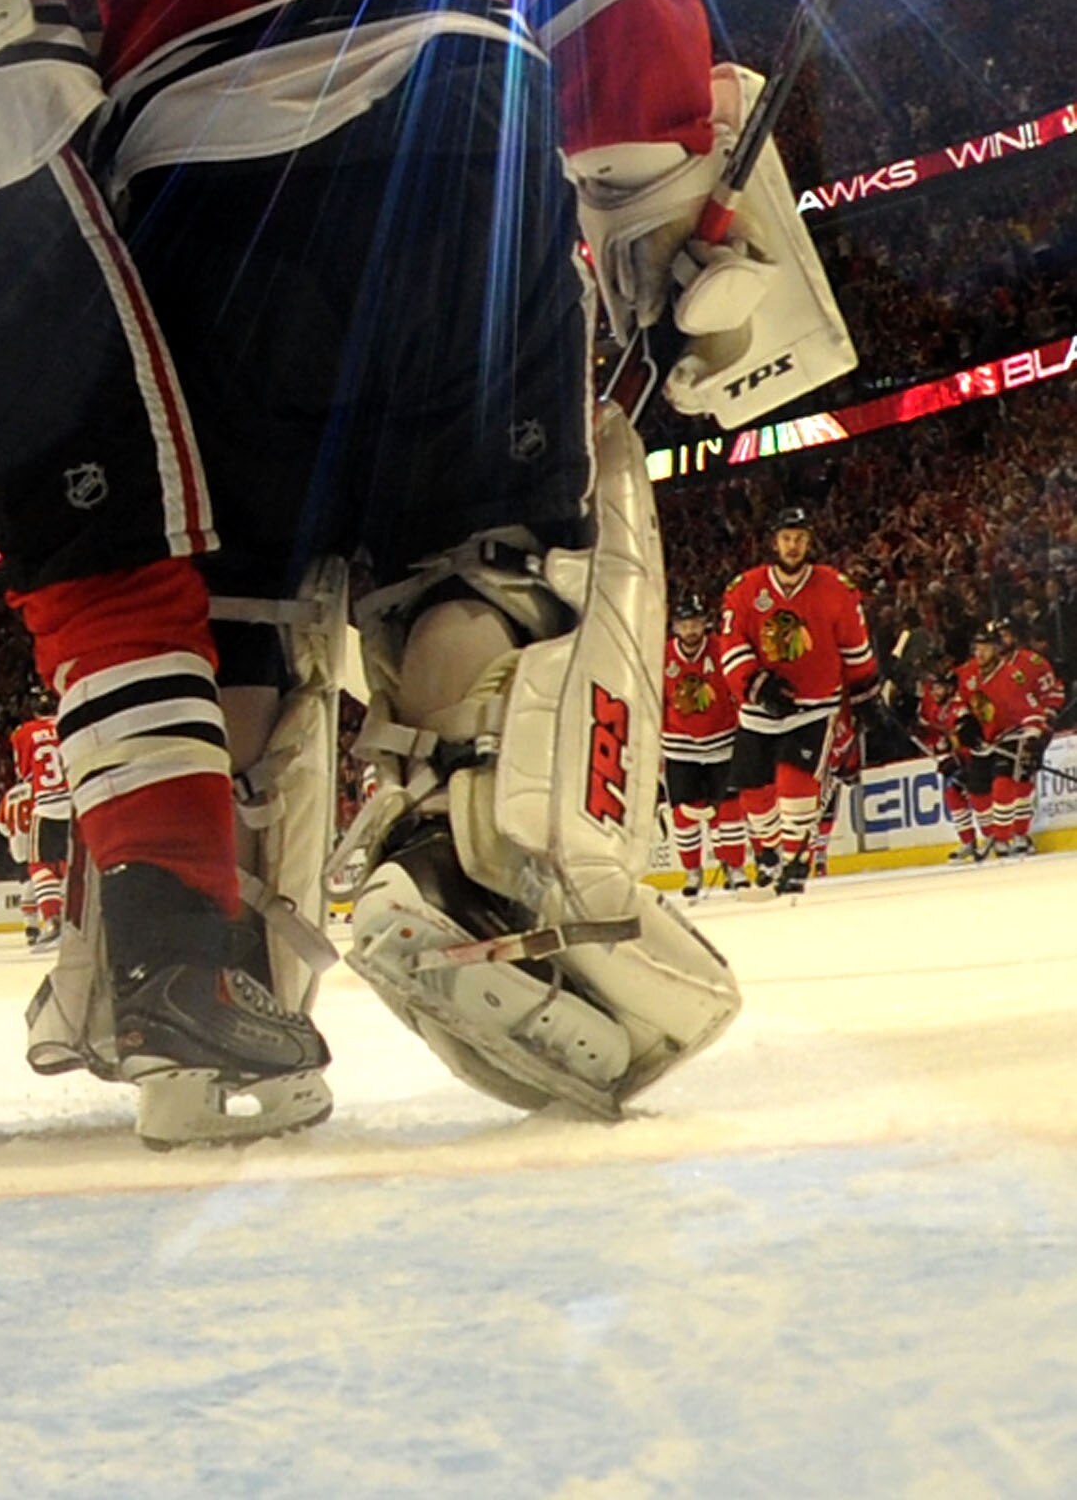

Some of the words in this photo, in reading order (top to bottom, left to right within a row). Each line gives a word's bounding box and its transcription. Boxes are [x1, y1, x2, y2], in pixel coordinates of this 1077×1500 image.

[796, 158, 918, 214] AWKS
[945, 119, 1043, 170] WIN!!
[723, 350, 795, 401] TPS
[703, 655, 716, 674] A
[583, 679, 631, 838] TPS
